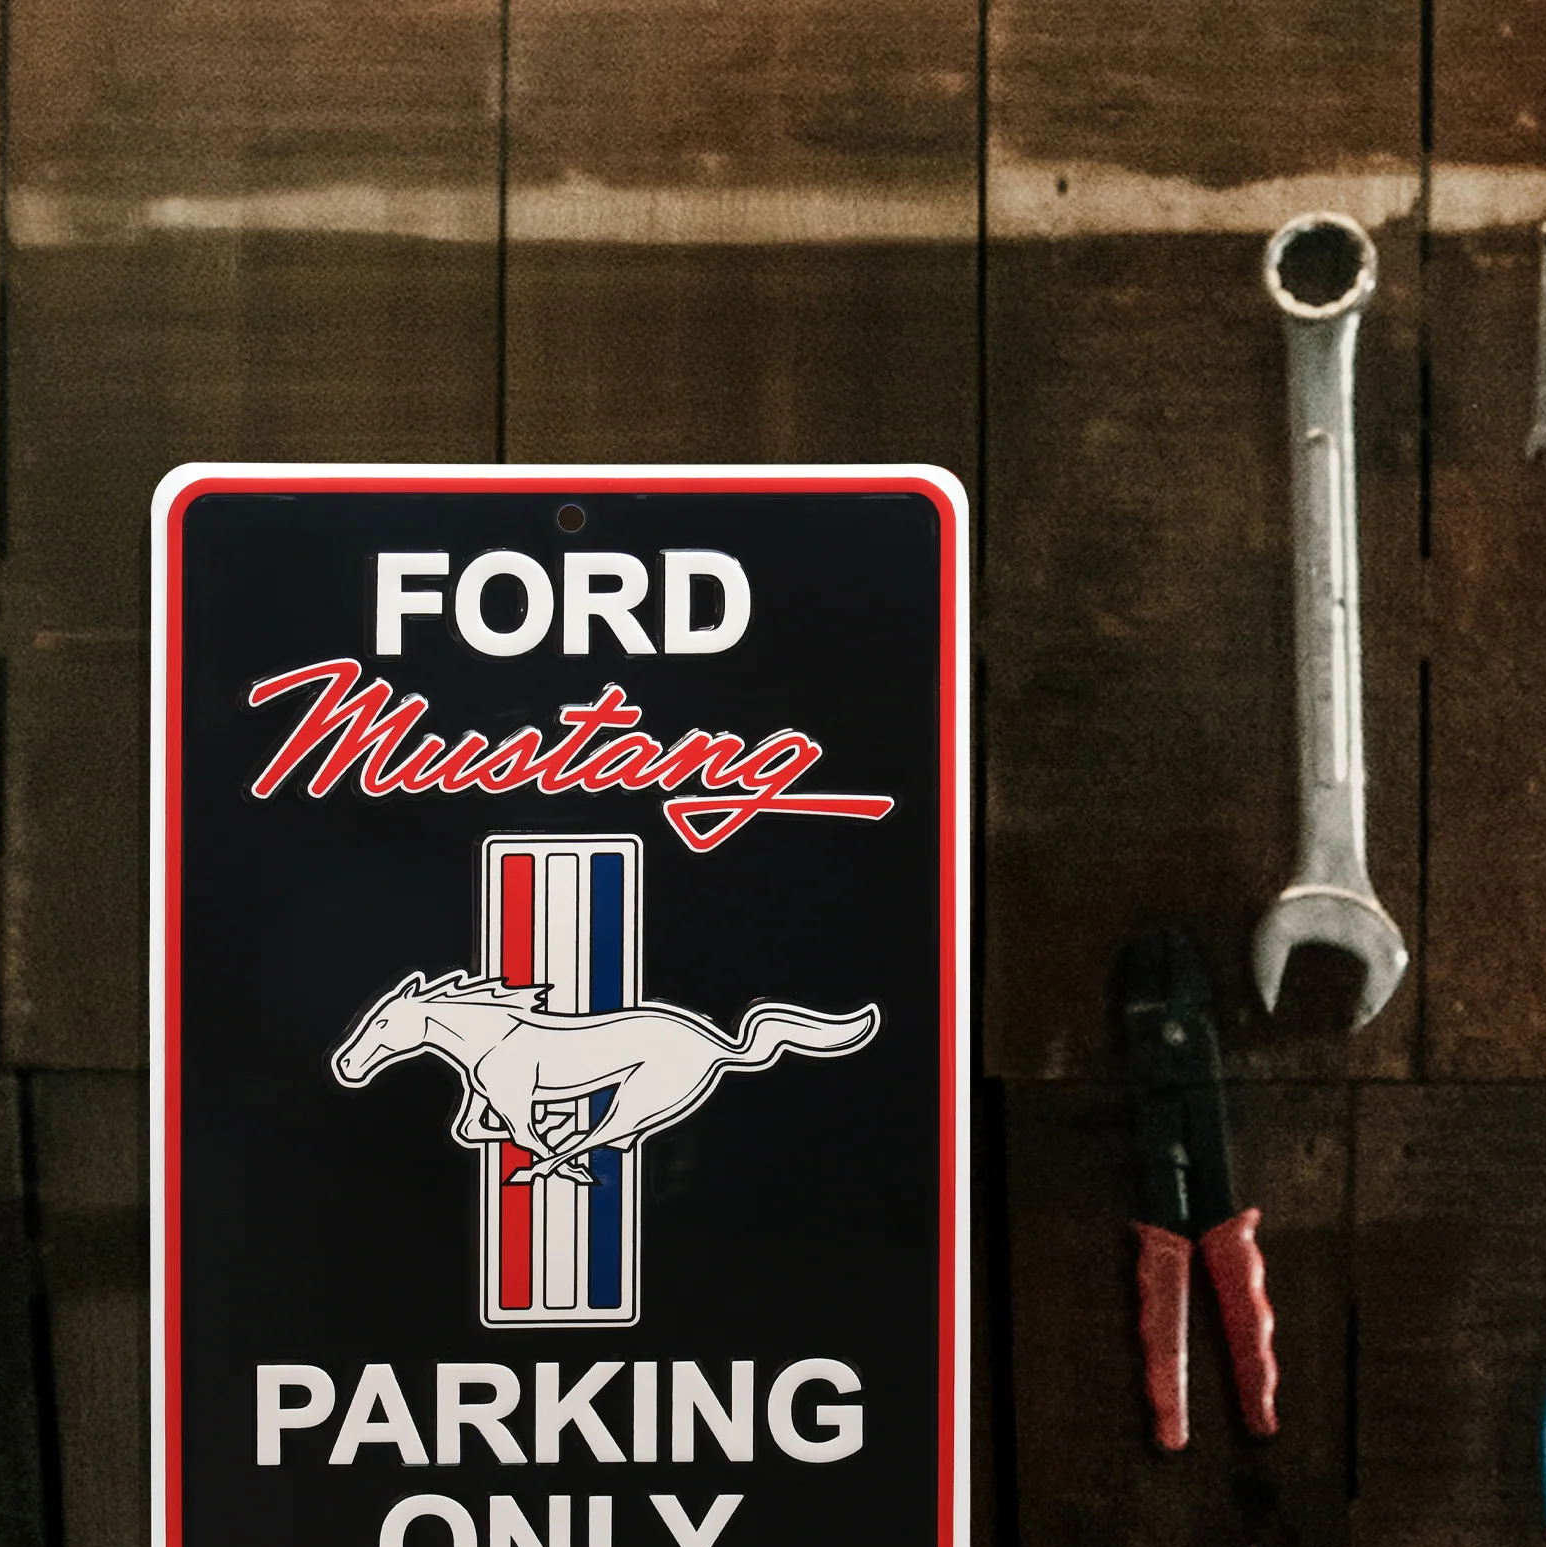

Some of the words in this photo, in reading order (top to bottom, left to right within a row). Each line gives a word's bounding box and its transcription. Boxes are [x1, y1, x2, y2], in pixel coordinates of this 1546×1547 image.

[376, 551, 752, 656] FORD
[250, 659, 895, 852] Mustang
[256, 1359, 864, 1466] PARKING
